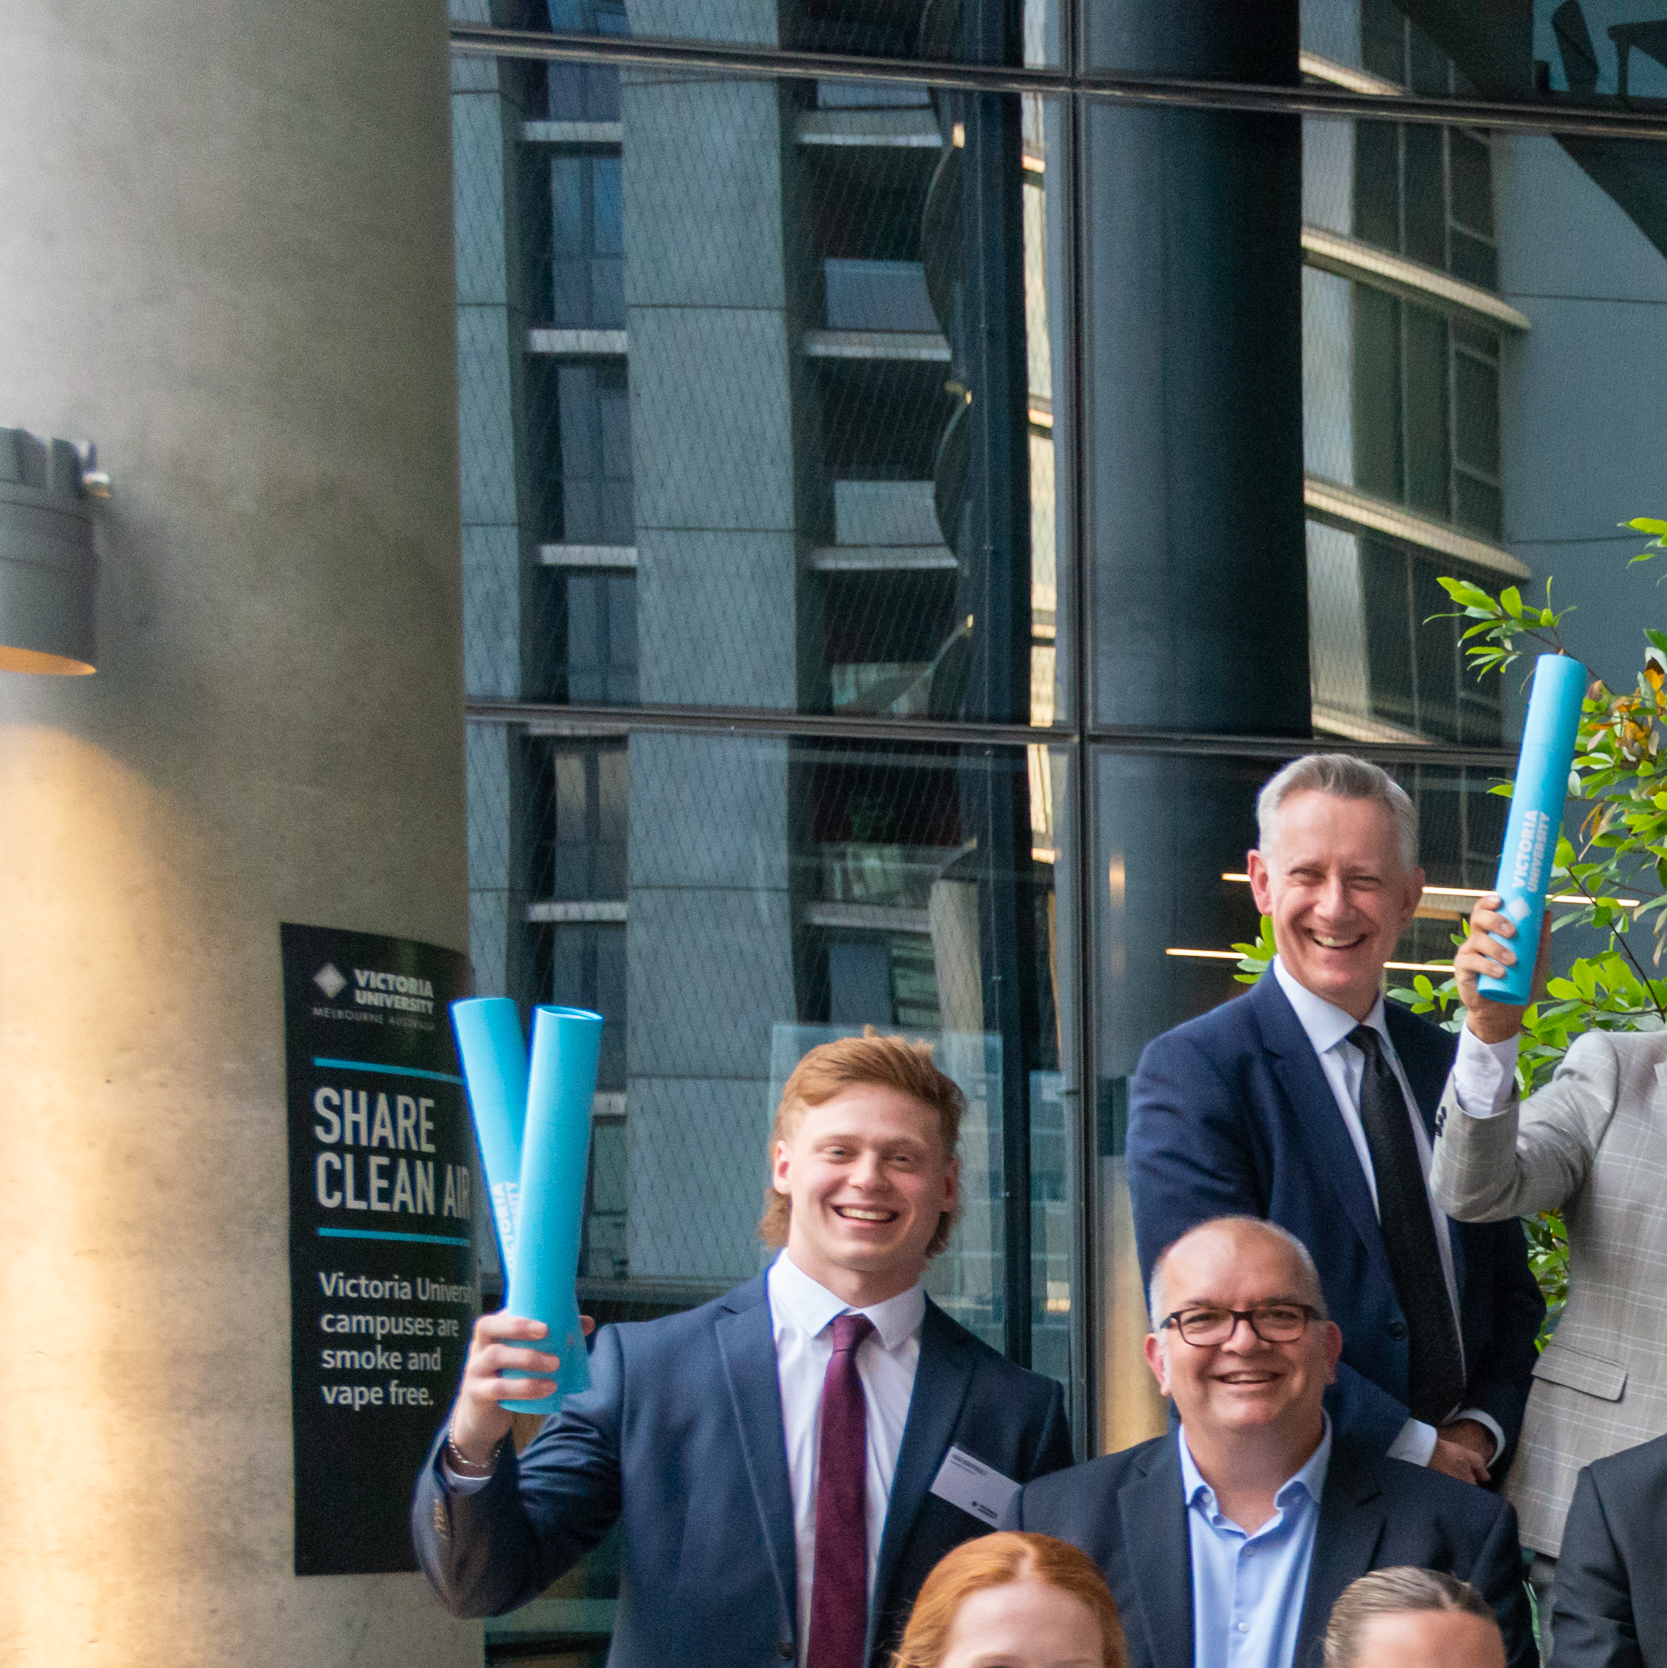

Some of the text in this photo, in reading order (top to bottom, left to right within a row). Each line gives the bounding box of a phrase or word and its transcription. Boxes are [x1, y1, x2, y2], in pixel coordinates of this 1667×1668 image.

[1511, 809, 1539, 888] VICTORIA
[1527, 811, 1550, 892] UNIVERSITY
[353, 968, 434, 998] VICTORIA
[354, 989, 434, 1014] UNIVERSITY
[314, 1087, 436, 1153] SHARE
[316, 1152, 435, 1216] CLEAN
[443, 1163, 471, 1219] AIR
[318, 1271, 412, 1300] Victoria
[320, 1313, 459, 1340] campuses are
[321, 1344, 441, 1371] smoke and
[320, 1379, 434, 1411] vape free.
